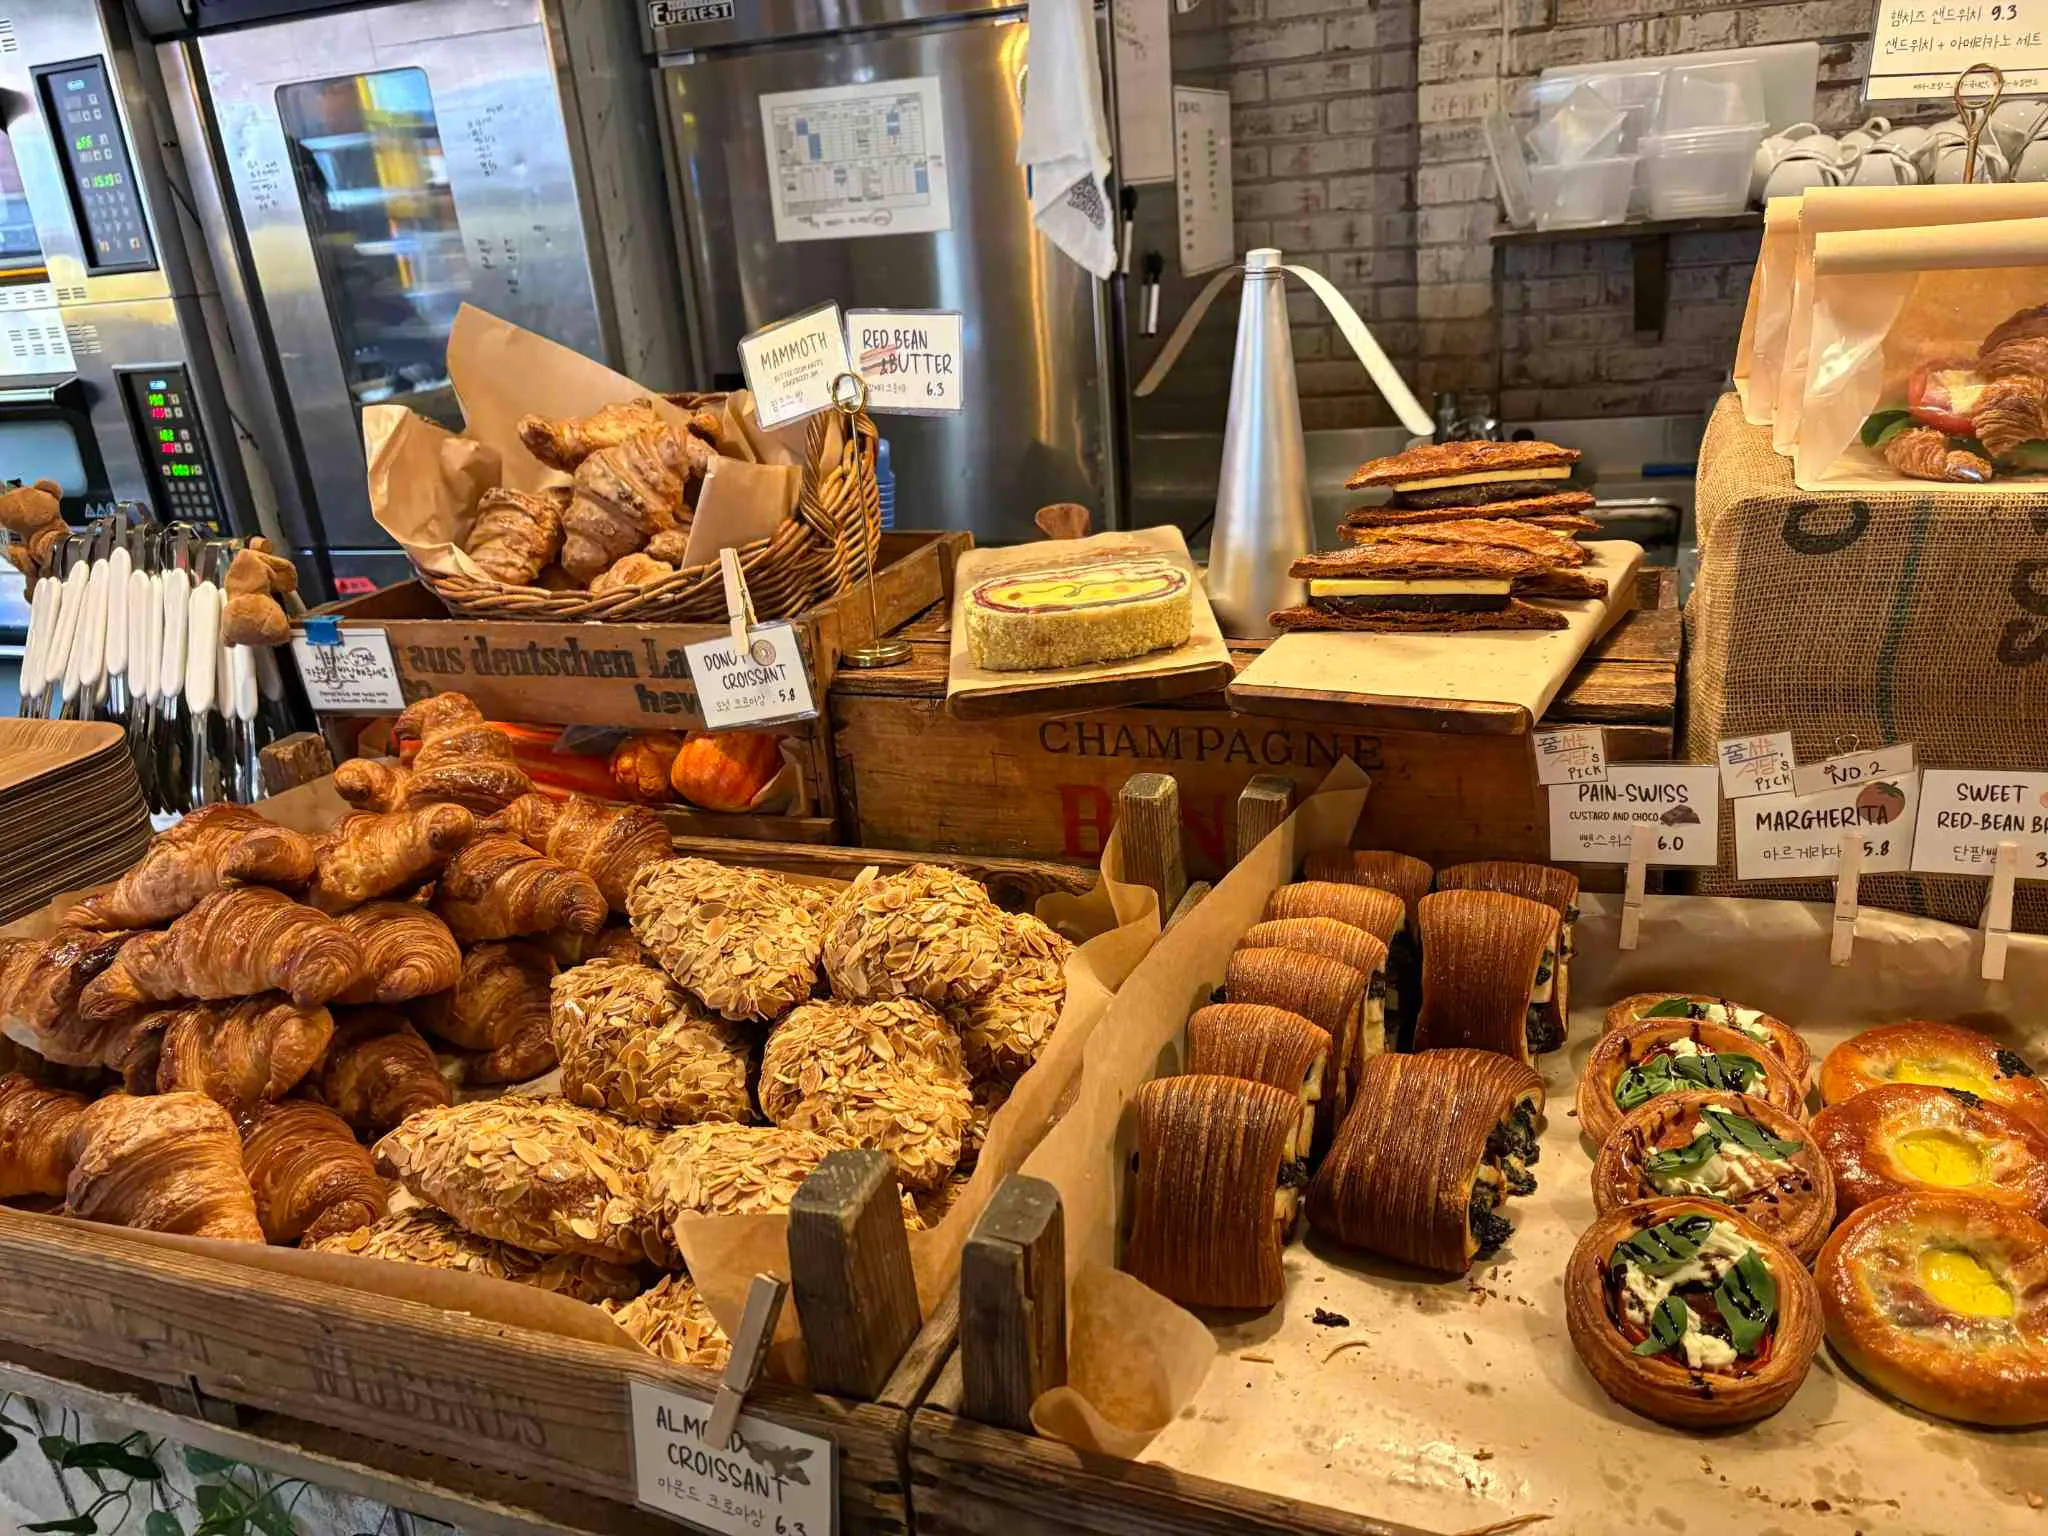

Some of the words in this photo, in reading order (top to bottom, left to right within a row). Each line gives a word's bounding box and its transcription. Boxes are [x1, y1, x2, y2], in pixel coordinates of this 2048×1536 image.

[1890, 9, 1926, 28] 햄치즈
[1932, 6, 1982, 24] 샌드위치
[1991, 4, 2017, 21] 9.3
[1885, 37, 1934, 55] 샌드위치
[1950, 33, 2012, 50] 아메리카노
[2016, 32, 2043, 46] 세트
[863, 329, 888, 350] RED
[895, 330, 928, 350] BEAN
[761, 331, 828, 371] MAMMOTH
[926, 382, 944, 397] 6.3
[408, 645, 465, 674] aus
[470, 635, 639, 678] deutschen
[723, 664, 786, 690] CROISSANT
[778, 688, 795, 702] 5.8
[1039, 721, 1384, 770] CHAMPAGNE
[1568, 767, 1601, 780] PICK
[1755, 776, 1791, 792] PICK
[1579, 783, 1689, 803] PAIN-SWISS
[1956, 783, 2029, 804] SWEET
[1569, 811, 1610, 821] CUSTARD
[1612, 812, 1630, 822] AND
[1632, 812, 1659, 822] CHOCO
[1756, 805, 1888, 831] MARGHERITA
[1937, 811, 2025, 832] RED-BEAN
[1657, 836, 1684, 851] 6.0
[1763, 844, 1842, 861] 마르게리따
[1863, 840, 1890, 857] 5.8
[656, 1406, 744, 1454] ALMD
[667, 1443, 789, 1504] CROISSANT
[658, 1477, 700, 1501] 아몬드
[776, 1516, 805, 1536] 6.3
